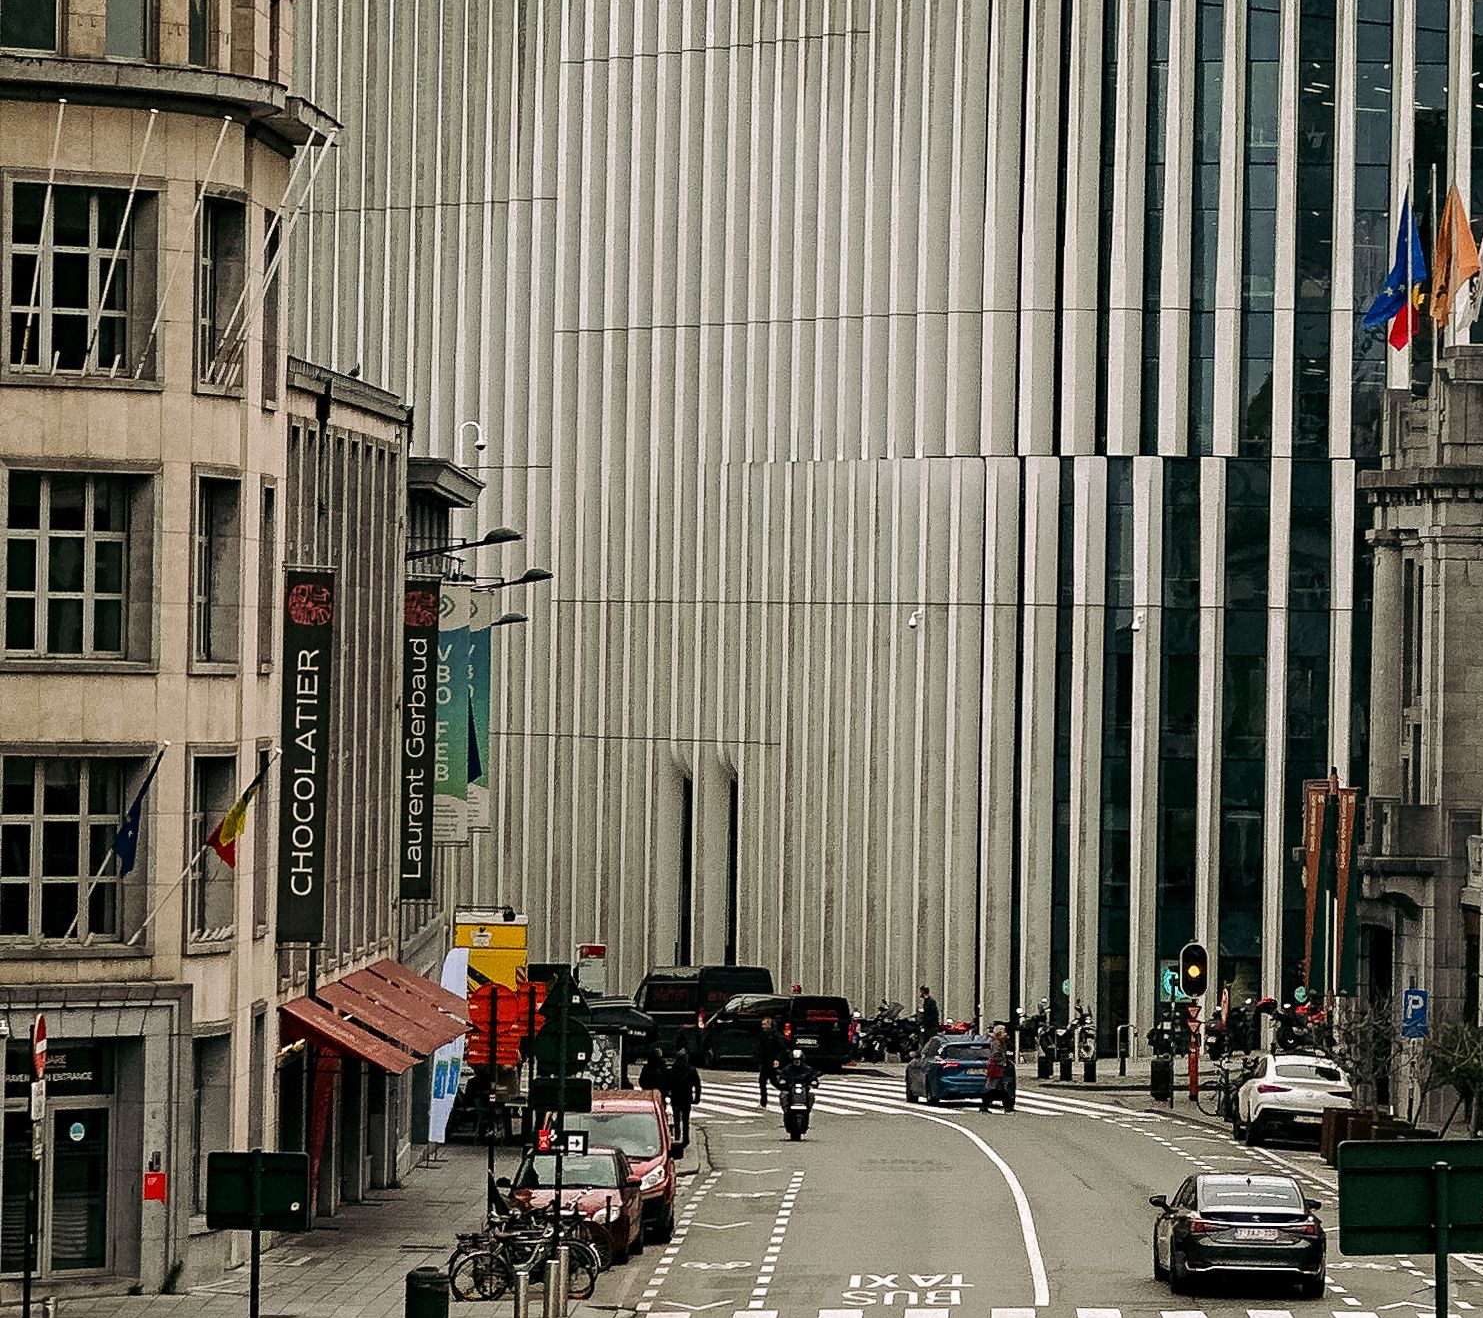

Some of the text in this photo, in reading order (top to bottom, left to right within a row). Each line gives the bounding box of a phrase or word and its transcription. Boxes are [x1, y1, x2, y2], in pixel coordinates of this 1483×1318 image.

[436, 643, 451, 705] VBO
[290, 648, 320, 897] CHOCOLATIER
[402, 637, 428, 880] Laurent Gerbaud
[1406, 994, 1424, 1019] P
[842, 1289, 962, 1305] BUS
[849, 1273, 974, 1288] TAXI
